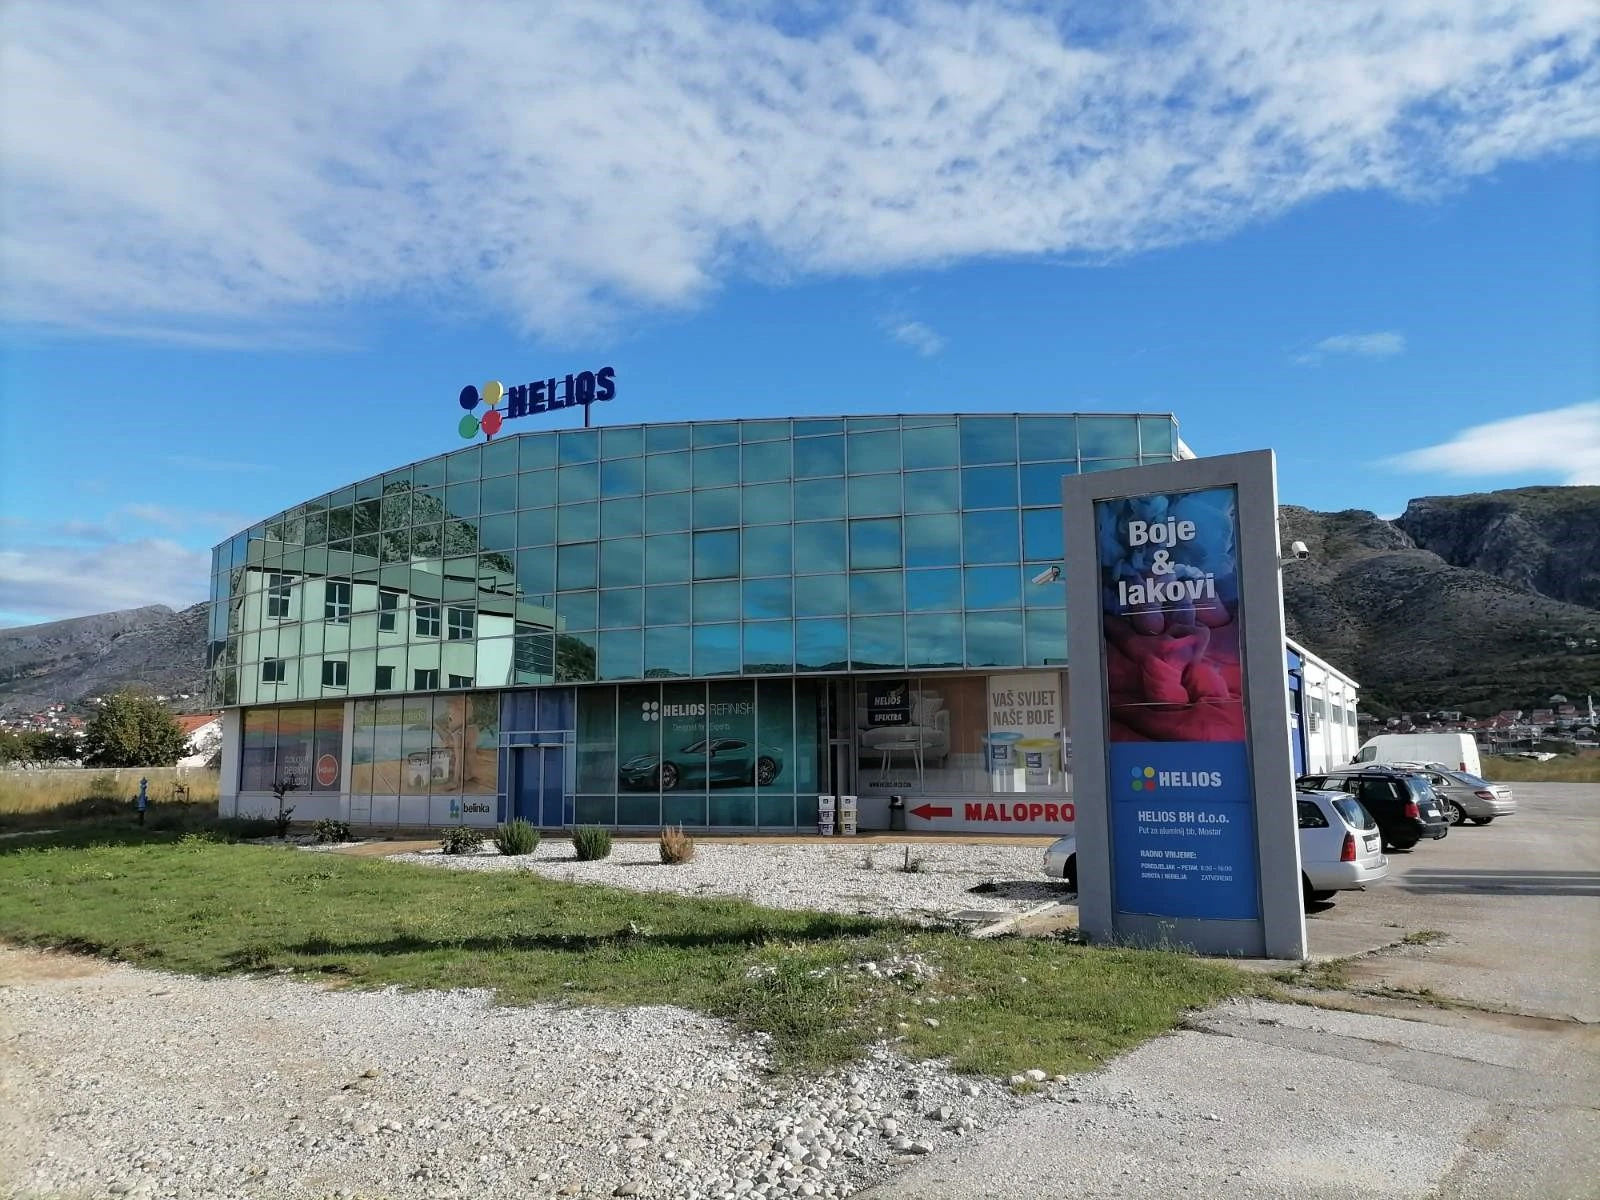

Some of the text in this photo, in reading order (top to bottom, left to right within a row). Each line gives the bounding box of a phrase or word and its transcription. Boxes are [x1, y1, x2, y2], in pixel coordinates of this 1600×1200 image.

[508, 366, 616, 419] HELIOS
[1129, 517, 1196, 548] Boje
[1151, 550, 1176, 576] &
[1118, 573, 1216, 606] lakovi
[874, 695, 902, 706] HELIOS
[992, 689, 1056, 707] VAŠ SVIJET
[663, 702, 754, 717] HELIOS REFINISH
[993, 708, 1055, 726] NAŠE BOJE
[1158, 771, 1222, 787] HELIOS
[463, 802, 490, 813] belinka
[1138, 810, 1230, 823] HELIOS BH d.o.o.
[1138, 826, 1149, 834] Put
[1198, 827, 1222, 836] Mostar
